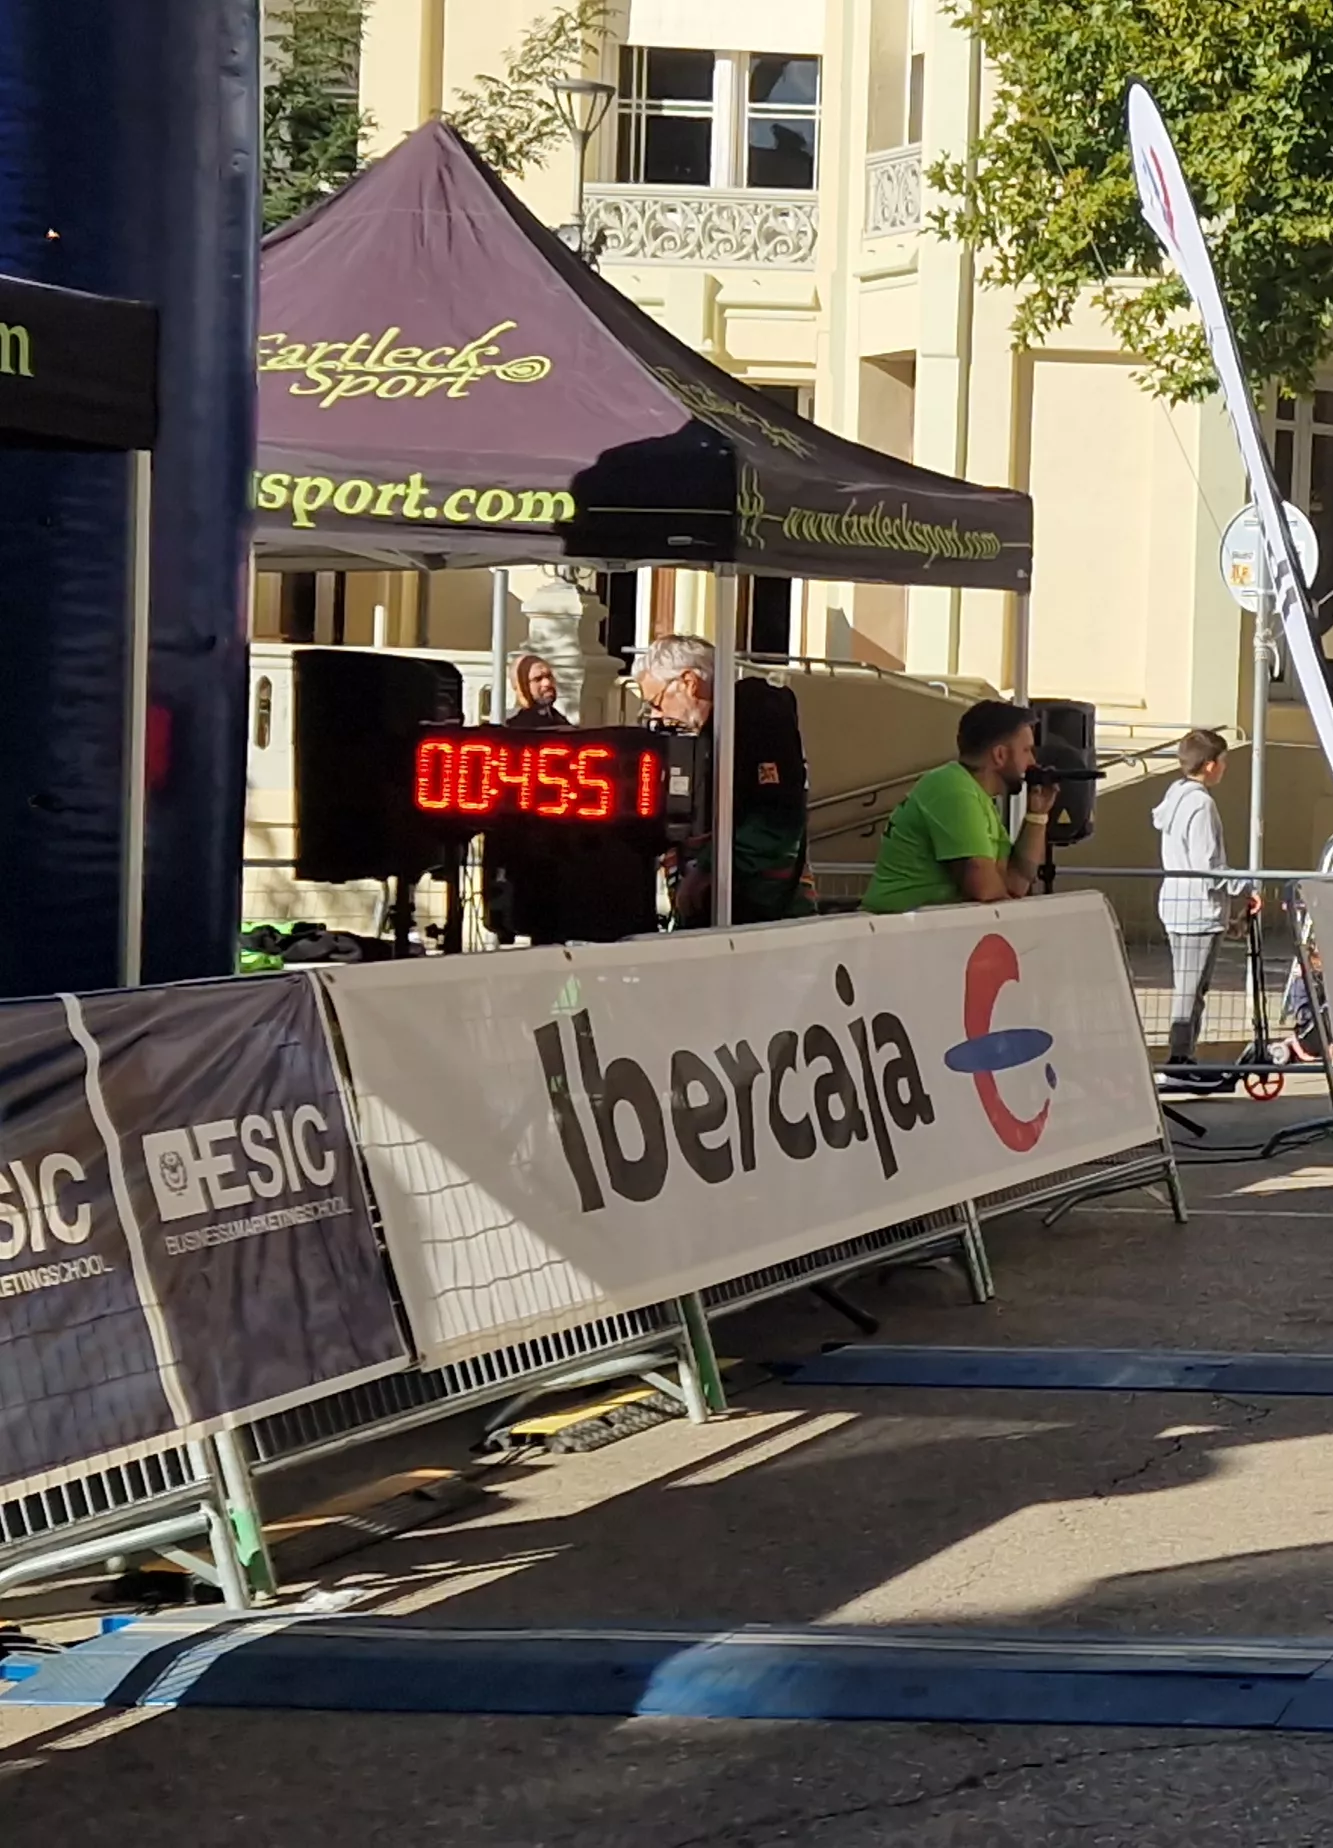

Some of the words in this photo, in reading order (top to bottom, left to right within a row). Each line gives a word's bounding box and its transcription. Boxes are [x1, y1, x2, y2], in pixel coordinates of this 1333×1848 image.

[289, 360, 487, 409] Sport
[251, 469, 576, 528] sport.com
[782, 498, 1002, 570] www.fartlecksport.com
[415, 739, 658, 819] 00:45:51
[534, 963, 936, 1213] Ibercaja
[193, 1104, 338, 1212] ESIC
